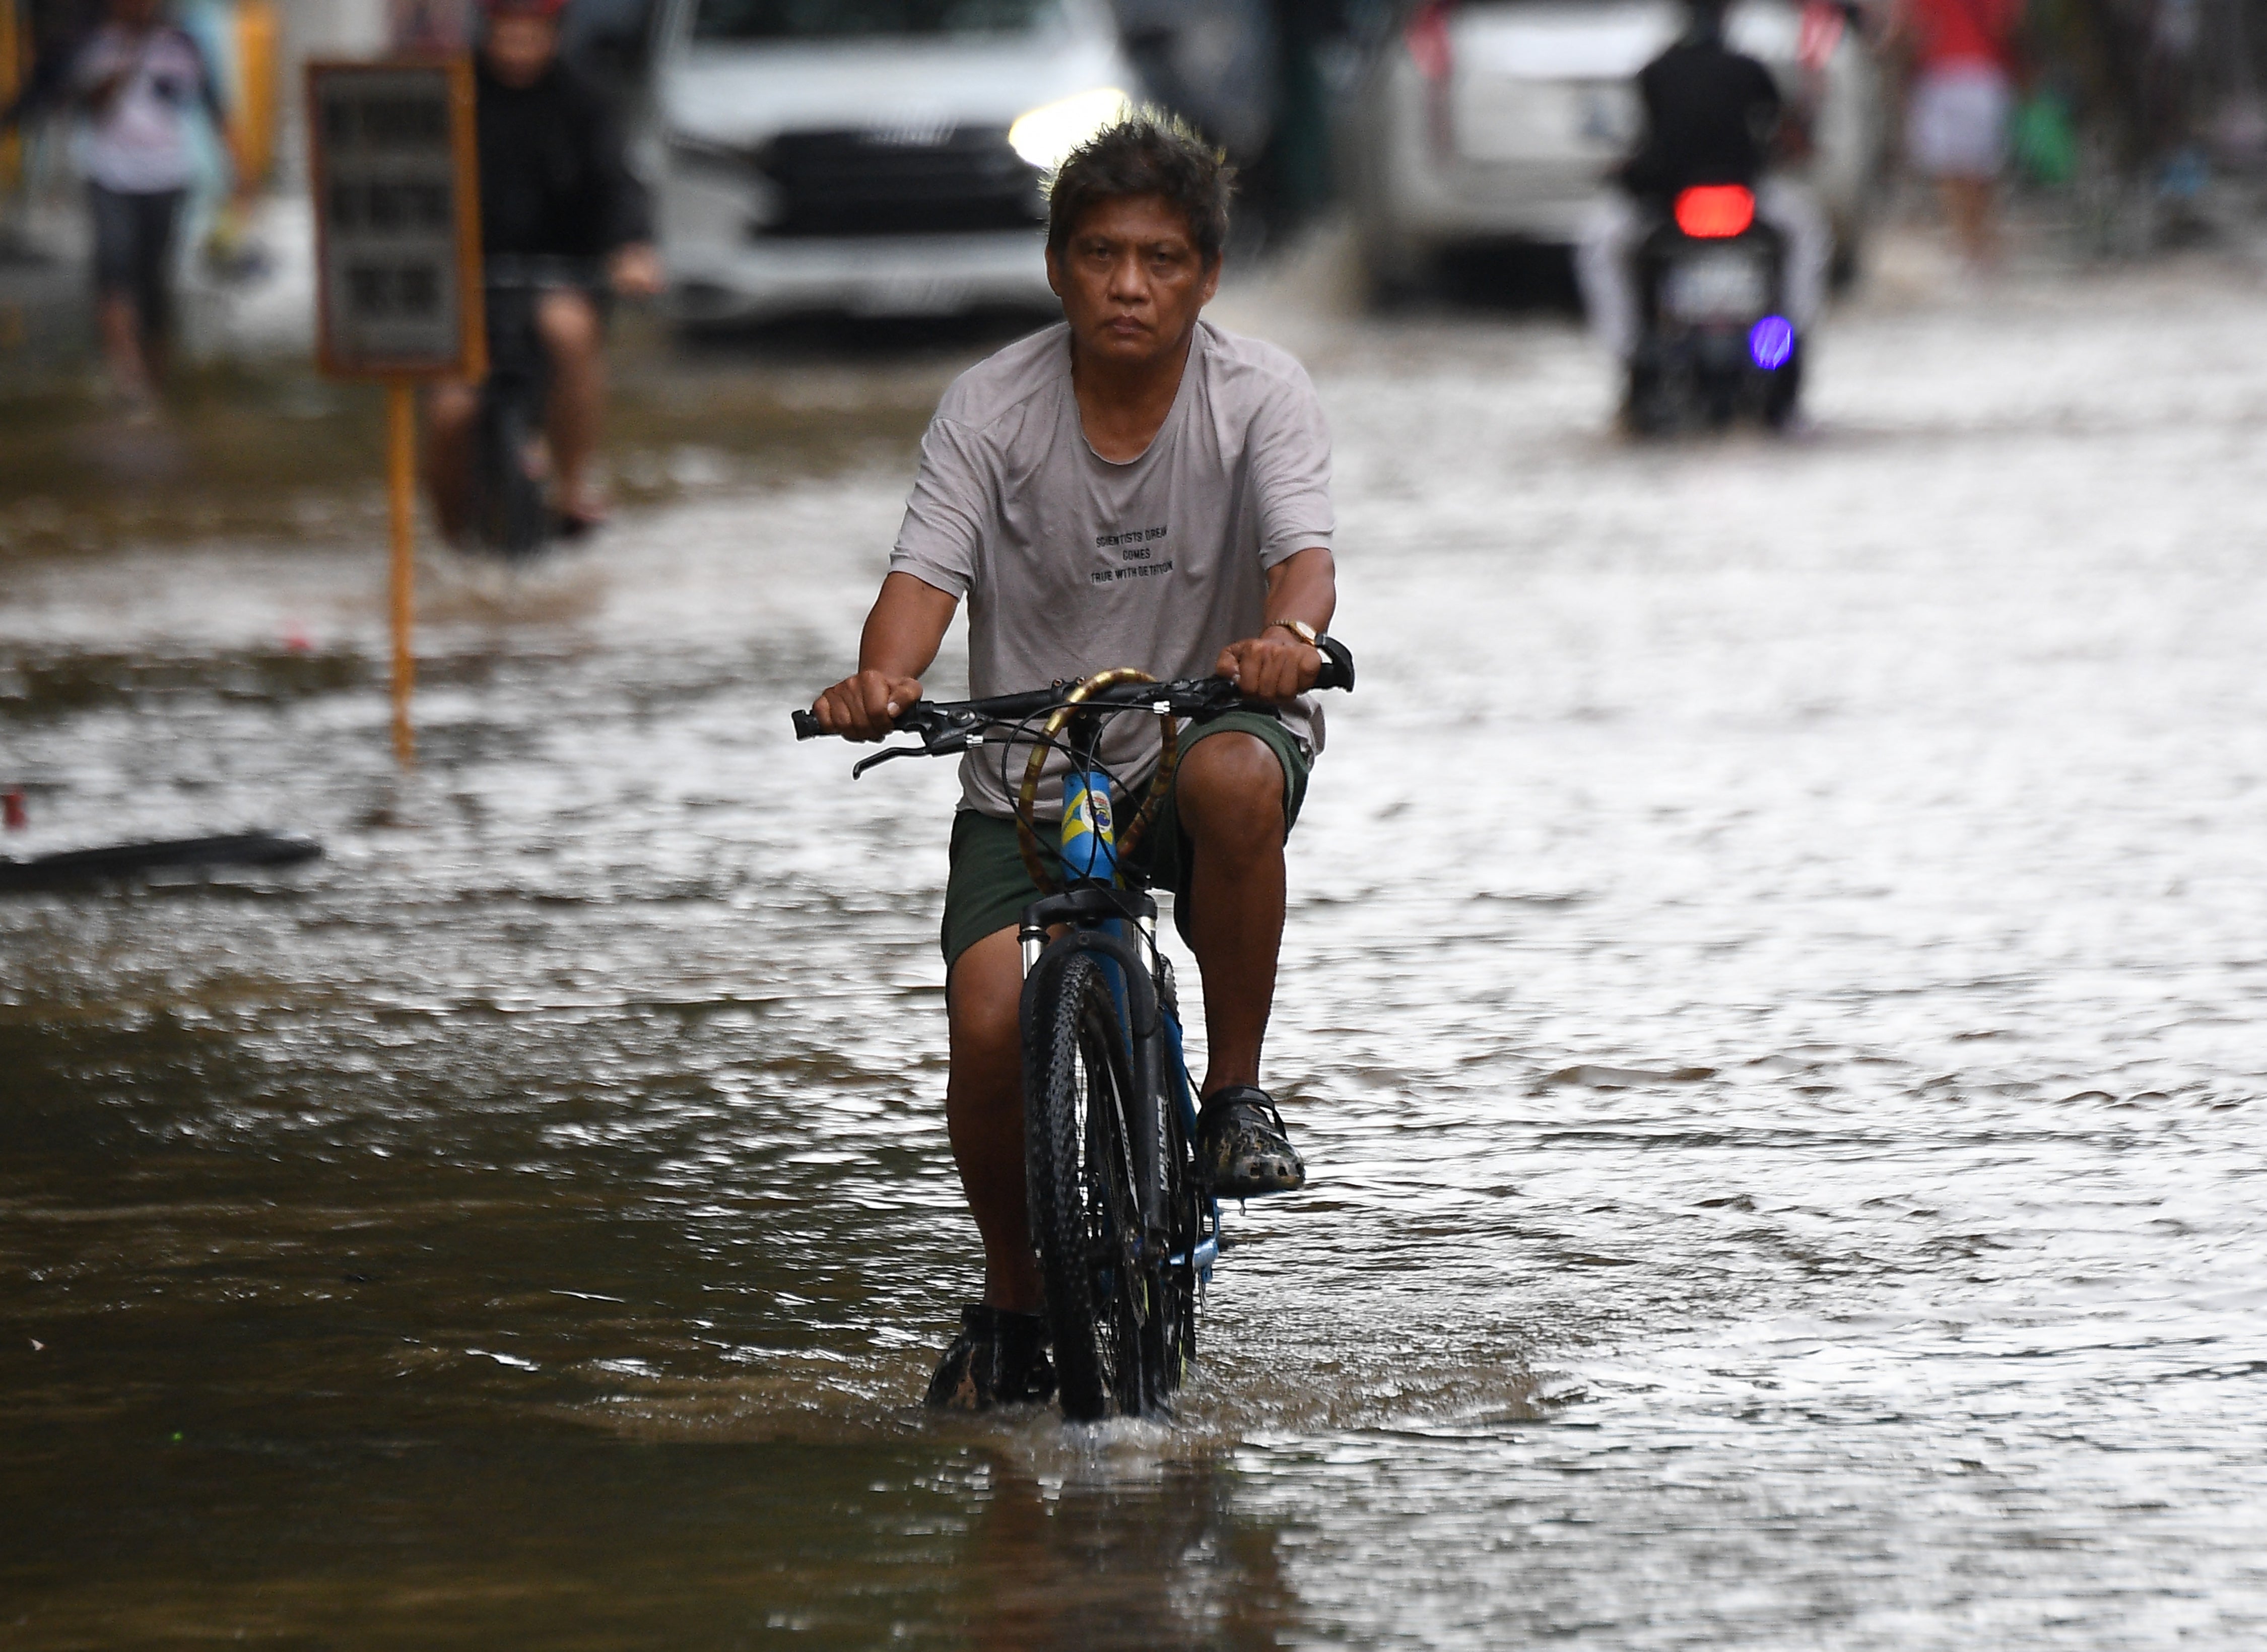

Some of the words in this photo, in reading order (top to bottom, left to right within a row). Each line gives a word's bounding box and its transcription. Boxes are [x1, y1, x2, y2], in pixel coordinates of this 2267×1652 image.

[1122, 548, 1151, 560] COMES
[1091, 570, 1113, 583] TRUE
[1115, 566, 1137, 579] WITH
